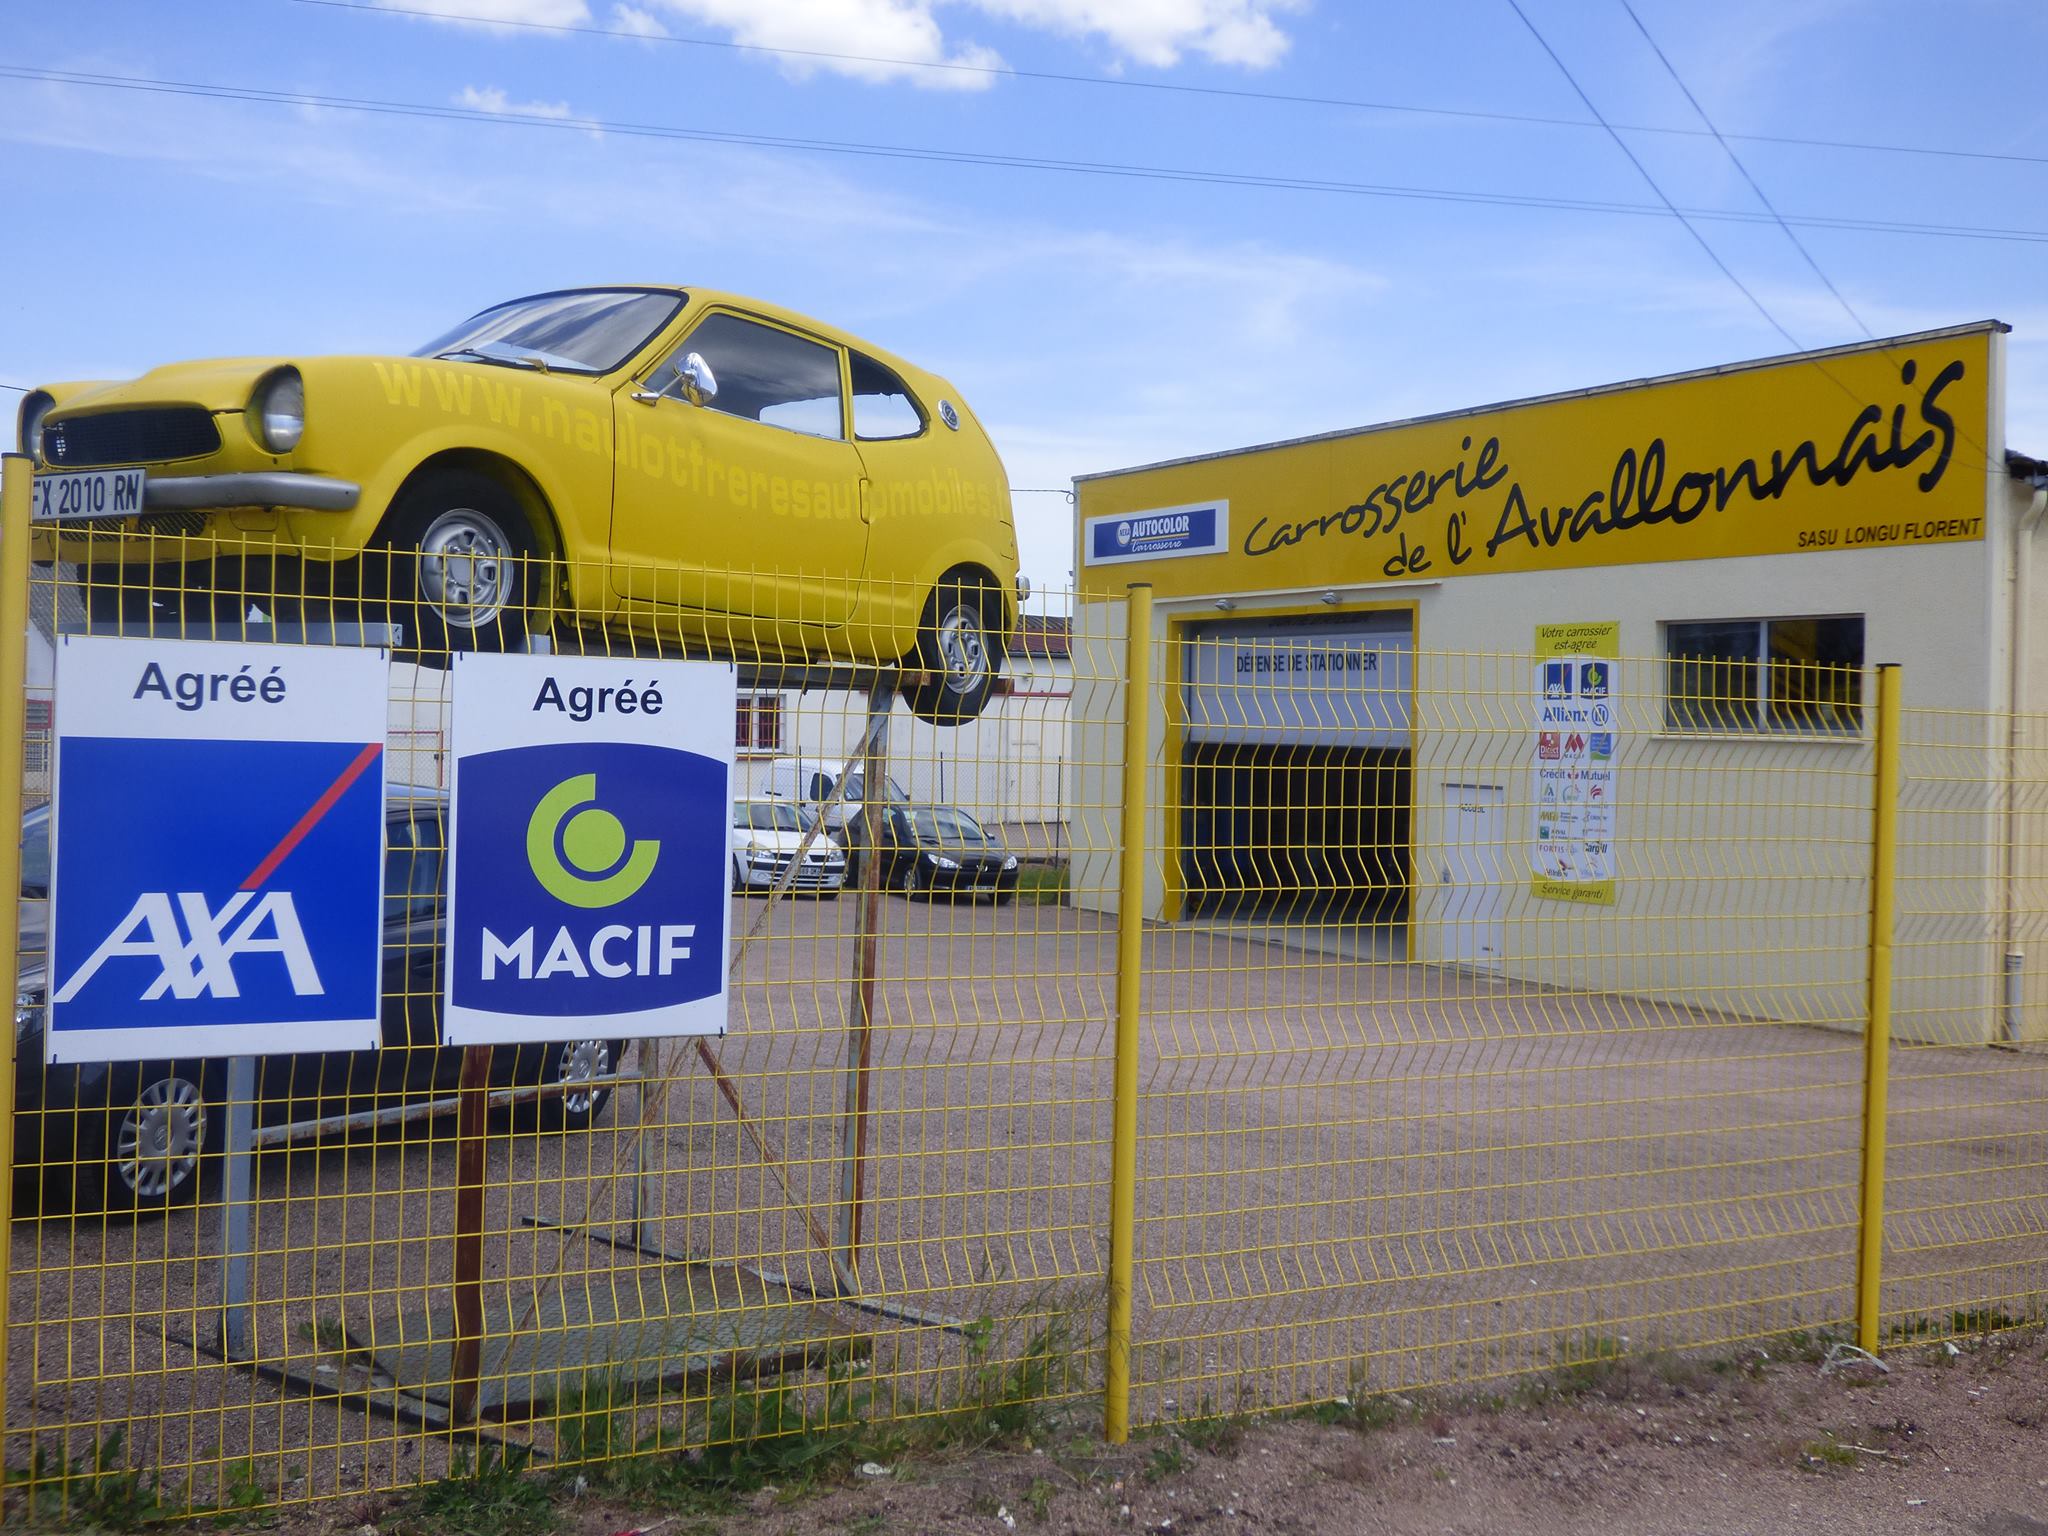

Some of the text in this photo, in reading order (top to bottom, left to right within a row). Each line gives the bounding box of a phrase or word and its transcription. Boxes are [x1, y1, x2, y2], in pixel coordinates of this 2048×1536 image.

[1383, 359, 1965, 576] de l' Avallonnais
[59, 476, 105, 514] 2010
[113, 473, 140, 511] RN
[1244, 436, 1508, 556] Carrosserie
[1132, 515, 1190, 538] AUTOCOLOR
[1798, 518, 1981, 547] SASU LONGU FLORENT
[1132, 540, 1182, 553] Carrosserie
[1542, 624, 1612, 638] Votre carrossier
[1288, 654, 1302, 671] DE
[1306, 652, 1377, 672] STATIONNER
[134, 662, 286, 711] Agréé
[533, 677, 663, 722] Agréé
[1543, 707, 1588, 722] Allianz
[1542, 884, 1603, 900] Service garanti
[53, 891, 325, 1003] AXA
[481, 924, 696, 980] MACIF
